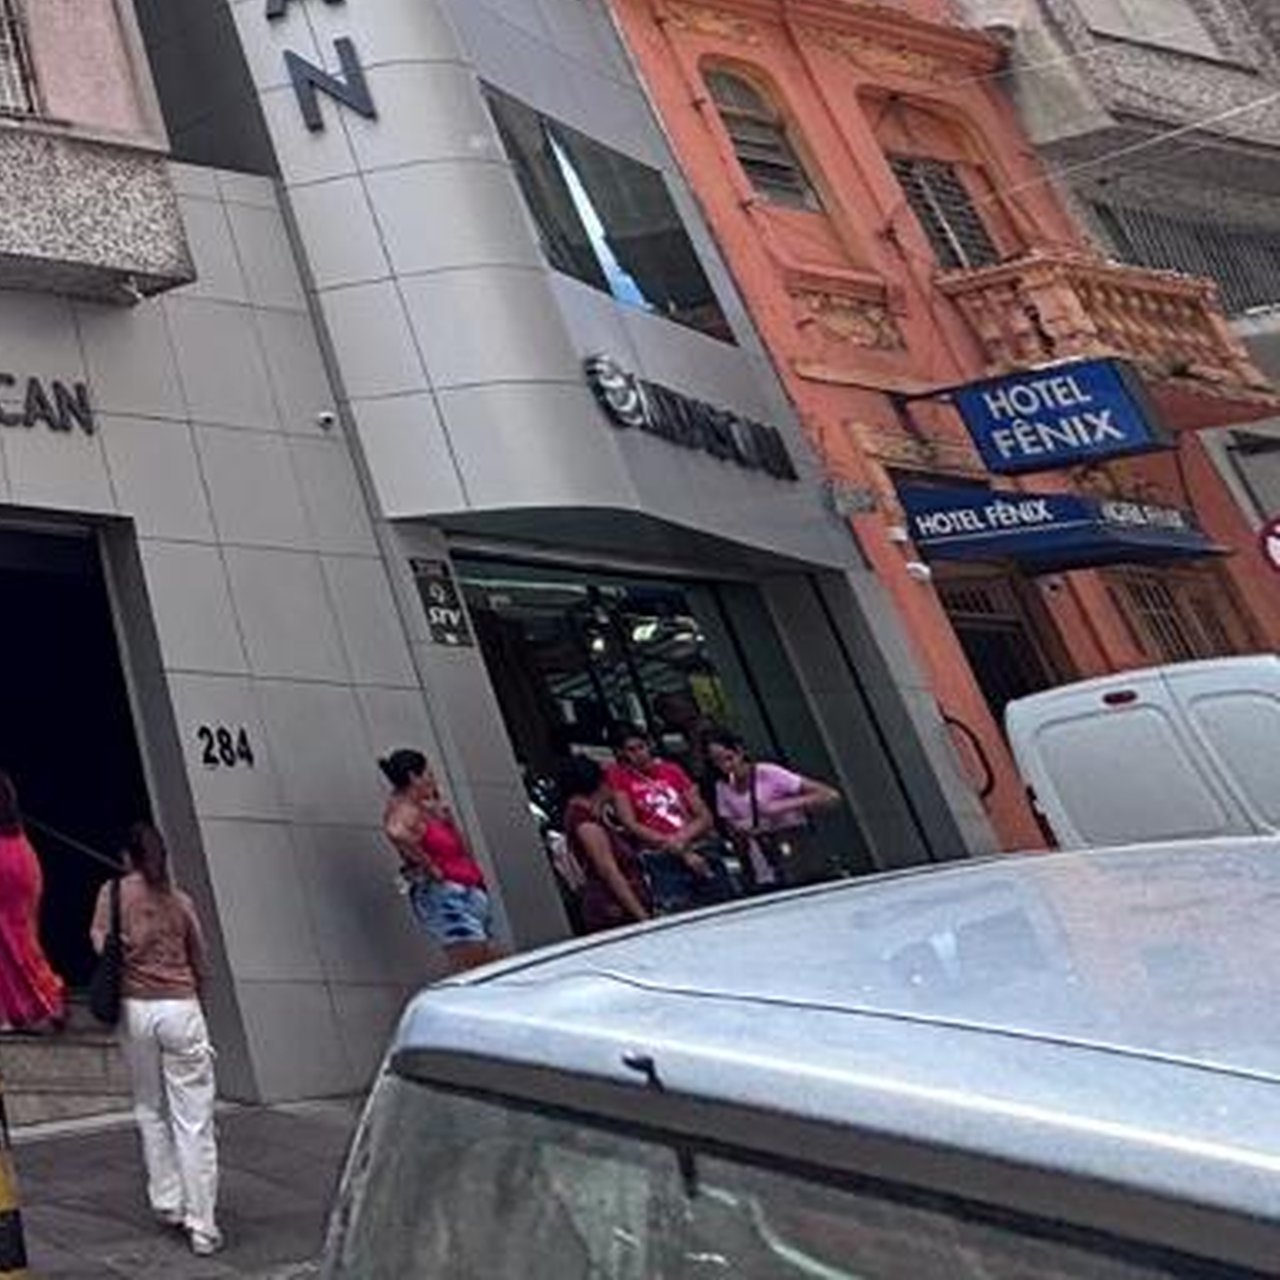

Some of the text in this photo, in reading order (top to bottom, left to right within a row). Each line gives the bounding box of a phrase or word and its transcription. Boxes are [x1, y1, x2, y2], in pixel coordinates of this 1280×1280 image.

[983, 375, 1093, 420] HOTEL
[991, 410, 1127, 459] FÊNIX
[916, 499, 1053, 537] HOTEL FÊNIX
[197, 726, 254, 768] 284
